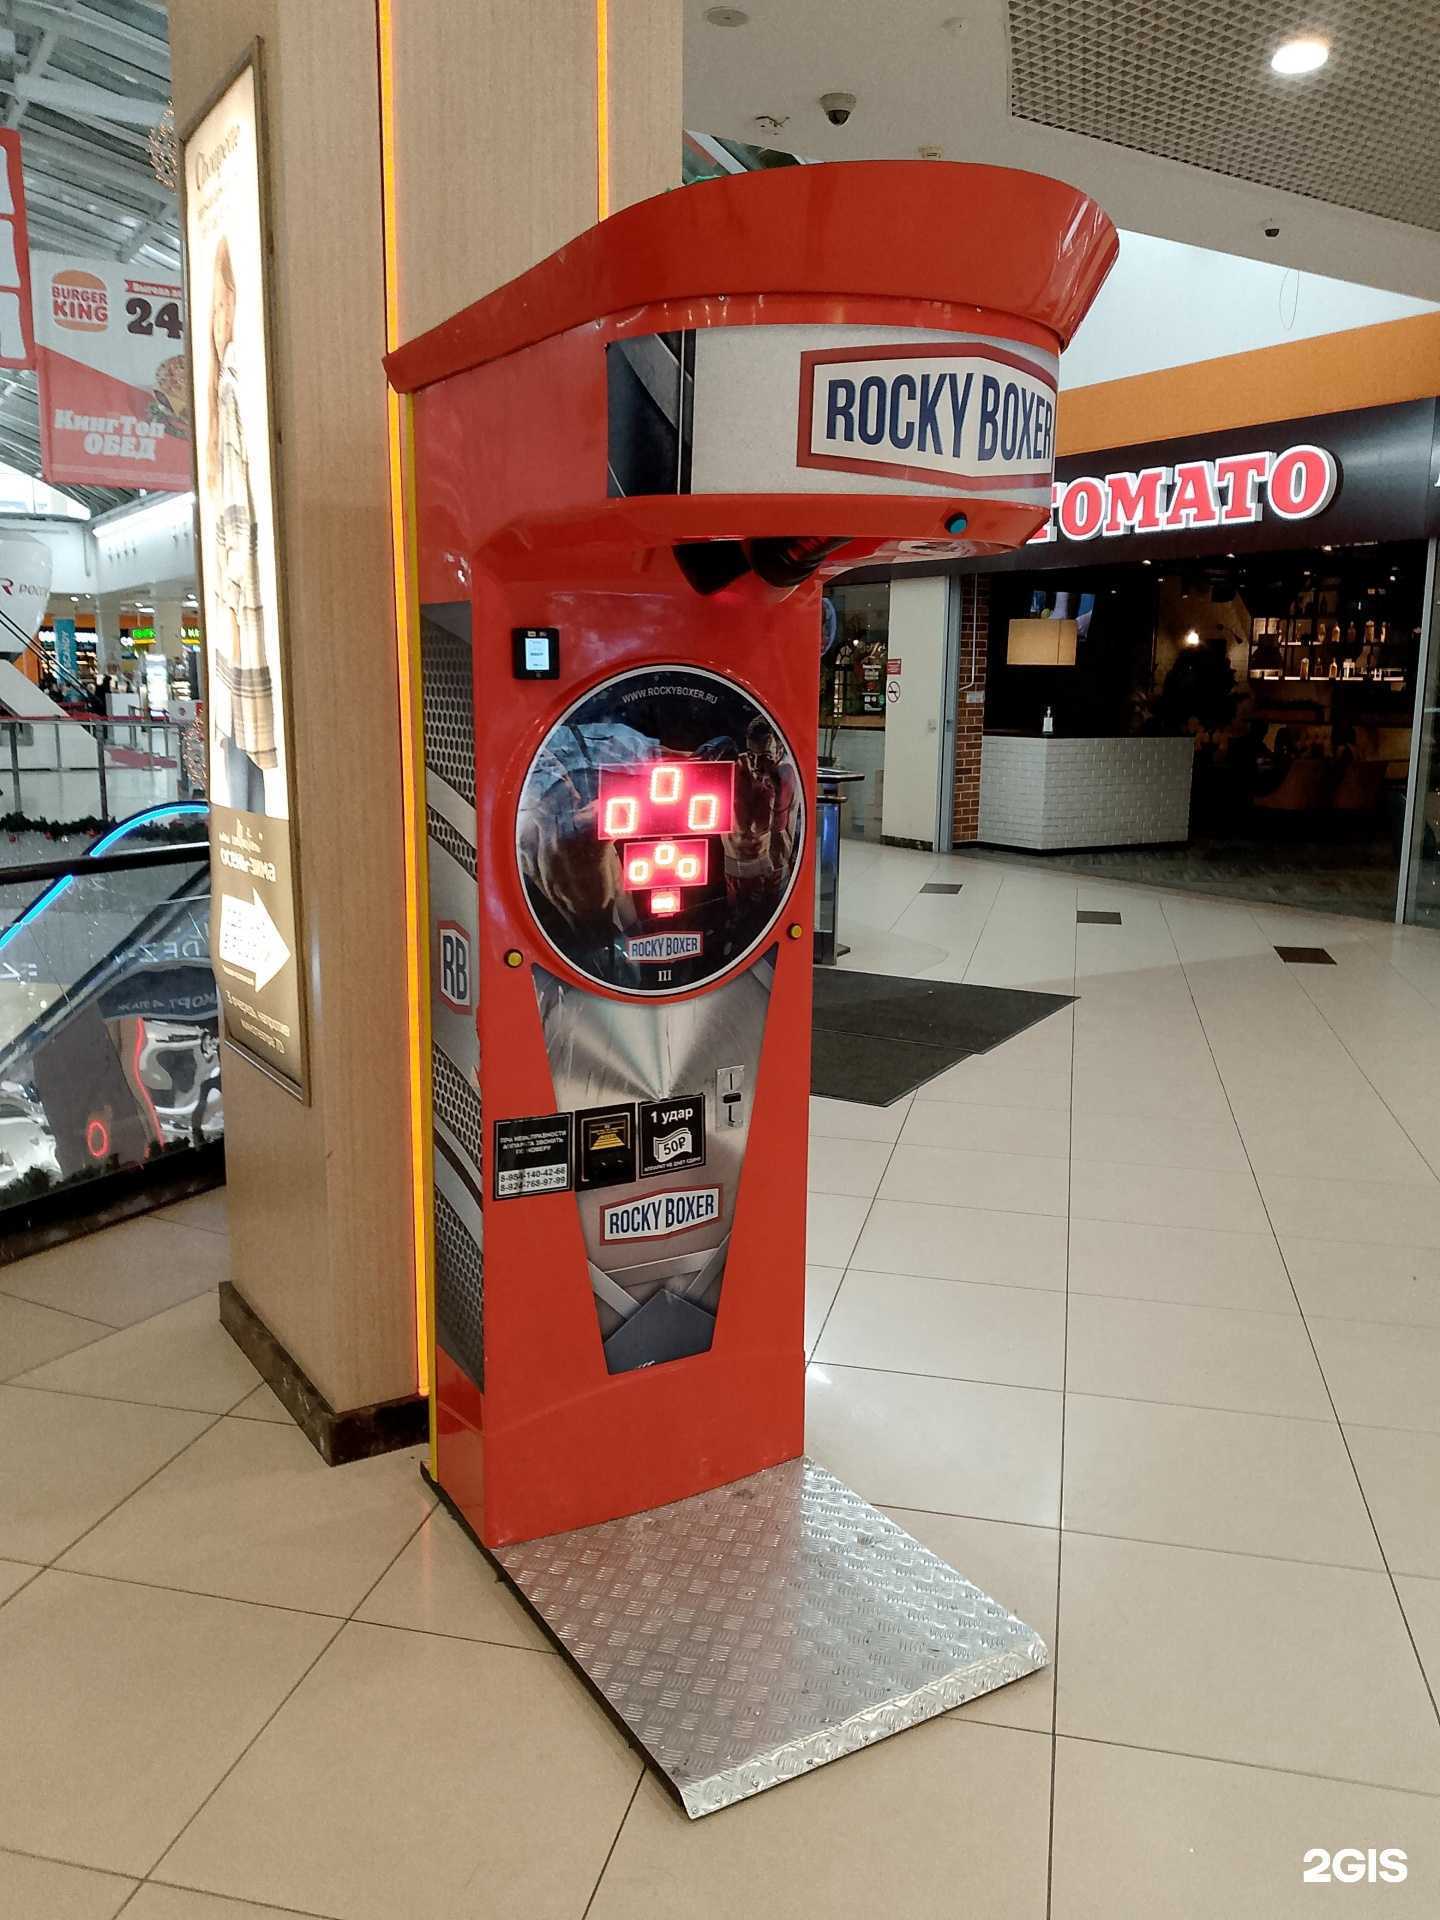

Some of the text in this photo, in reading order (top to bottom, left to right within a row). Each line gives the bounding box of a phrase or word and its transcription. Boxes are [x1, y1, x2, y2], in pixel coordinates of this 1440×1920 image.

[51, 285, 108, 306] BURGER
[53, 300, 108, 323] KING
[826, 372, 1053, 462] ROCKY BOXER
[84, 432, 156, 461] ОБЕД
[622, 686, 718, 704] WWW.ROCKYBOXER.RU
[632, 937, 698, 957] ROCKY BOXER
[443, 935, 467, 1000] RB
[651, 1108, 694, 1125] 1 удар
[609, 1194, 714, 1234] ROCKY BOXER
